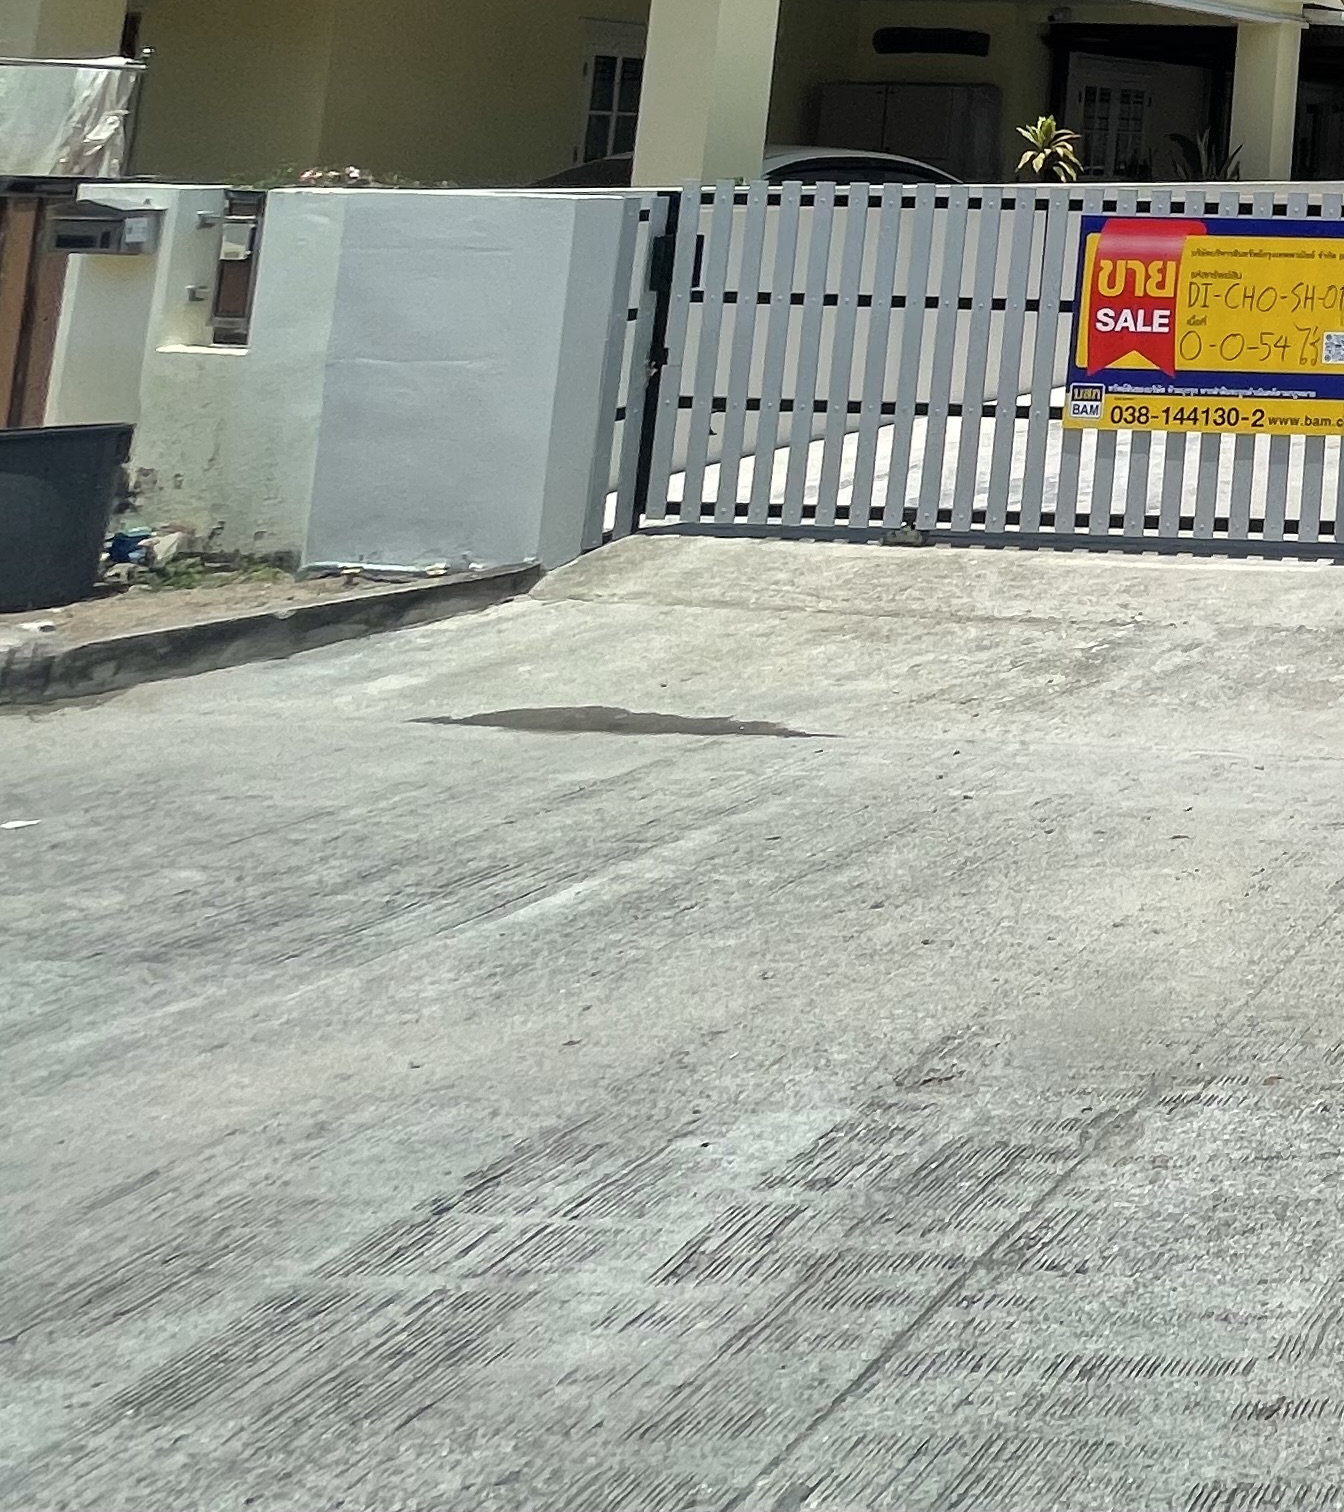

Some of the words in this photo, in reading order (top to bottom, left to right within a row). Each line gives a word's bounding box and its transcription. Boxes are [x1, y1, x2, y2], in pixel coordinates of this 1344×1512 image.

[1098, 259, 1175, 298] ขาย
[1096, 308, 1171, 333] SALE
[1072, 404, 1099, 416] BAM
[1110, 405, 1265, 427] 038-144130-2
